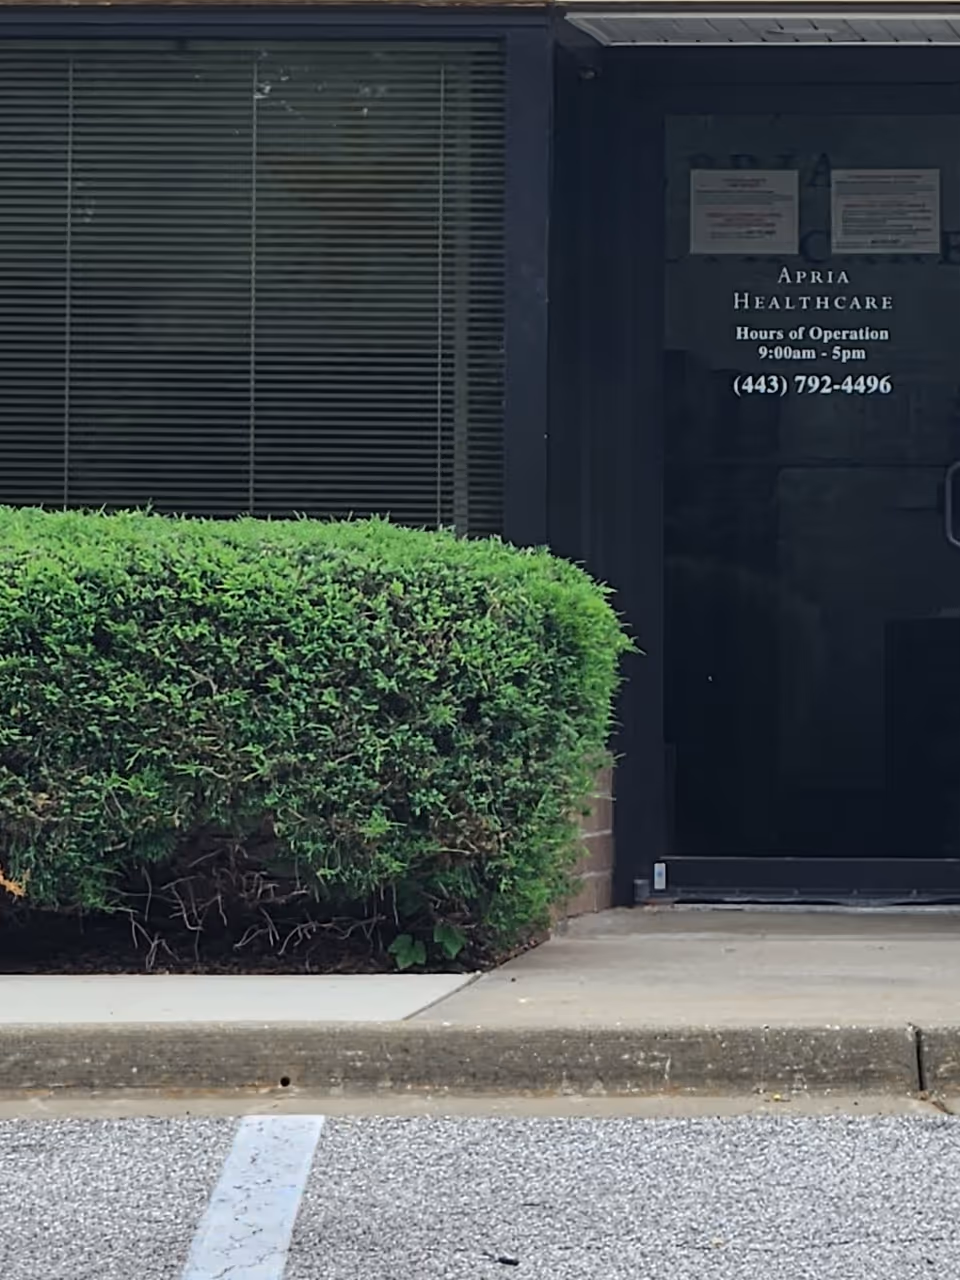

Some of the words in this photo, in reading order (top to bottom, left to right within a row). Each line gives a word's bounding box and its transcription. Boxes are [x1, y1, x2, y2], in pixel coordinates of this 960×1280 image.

[777, 266, 850, 284] APRIA
[733, 292, 894, 310] HEALTHCARE
[735, 326, 784, 341] Hours
[788, 326, 806, 341] of
[809, 326, 889, 344] Operation
[758, 345, 816, 360] 9:00am
[831, 345, 866, 363] 5pm
[733, 375, 788, 396] (443)
[794, 375, 892, 394] 792-4496
